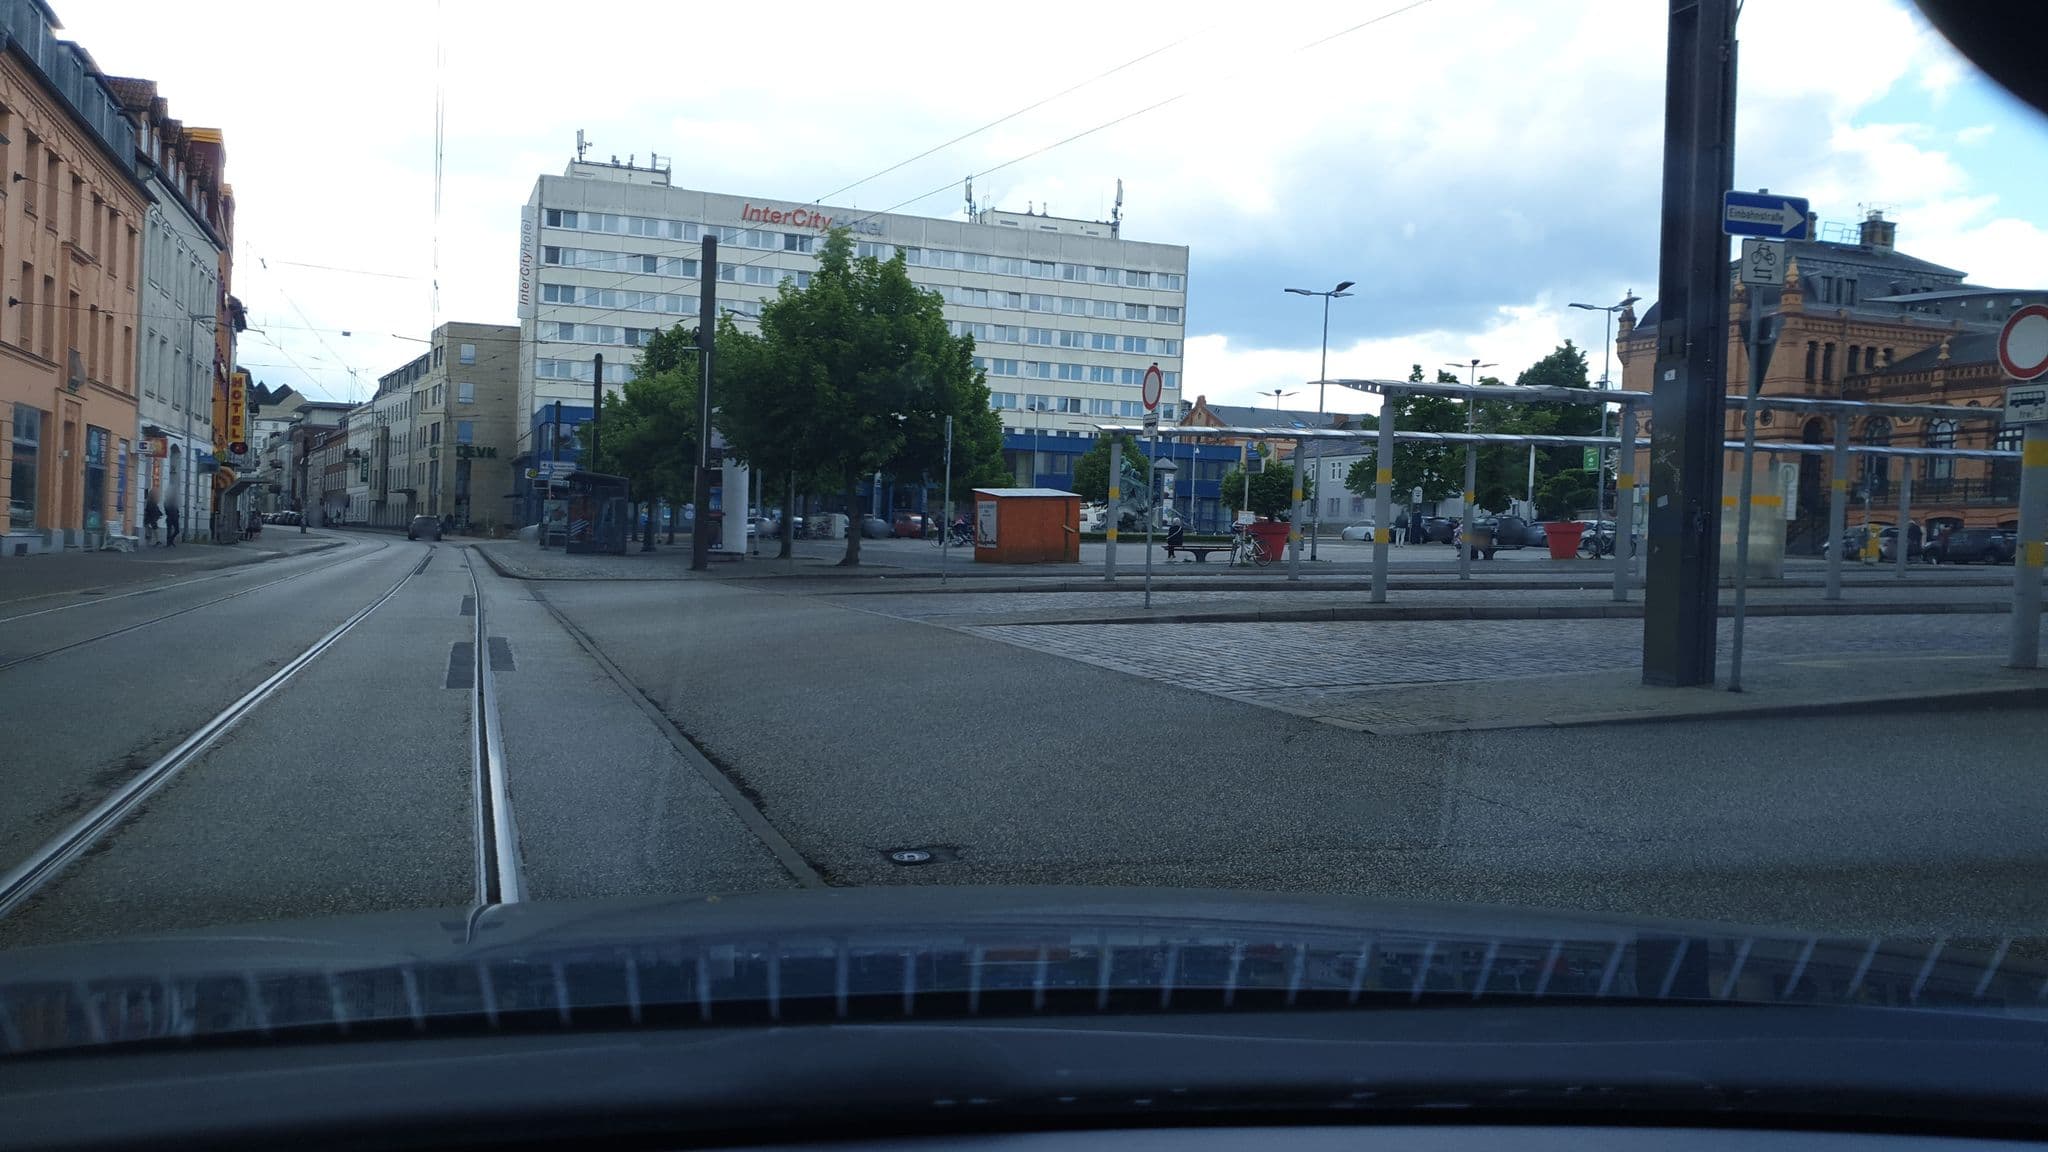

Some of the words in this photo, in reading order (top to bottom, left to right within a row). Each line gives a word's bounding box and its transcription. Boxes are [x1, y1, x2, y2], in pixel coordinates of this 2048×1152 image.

[520, 219, 533, 305] InterCityHotel
[231, 377, 243, 438] HOTEL
[456, 445, 497, 458] DEVK
